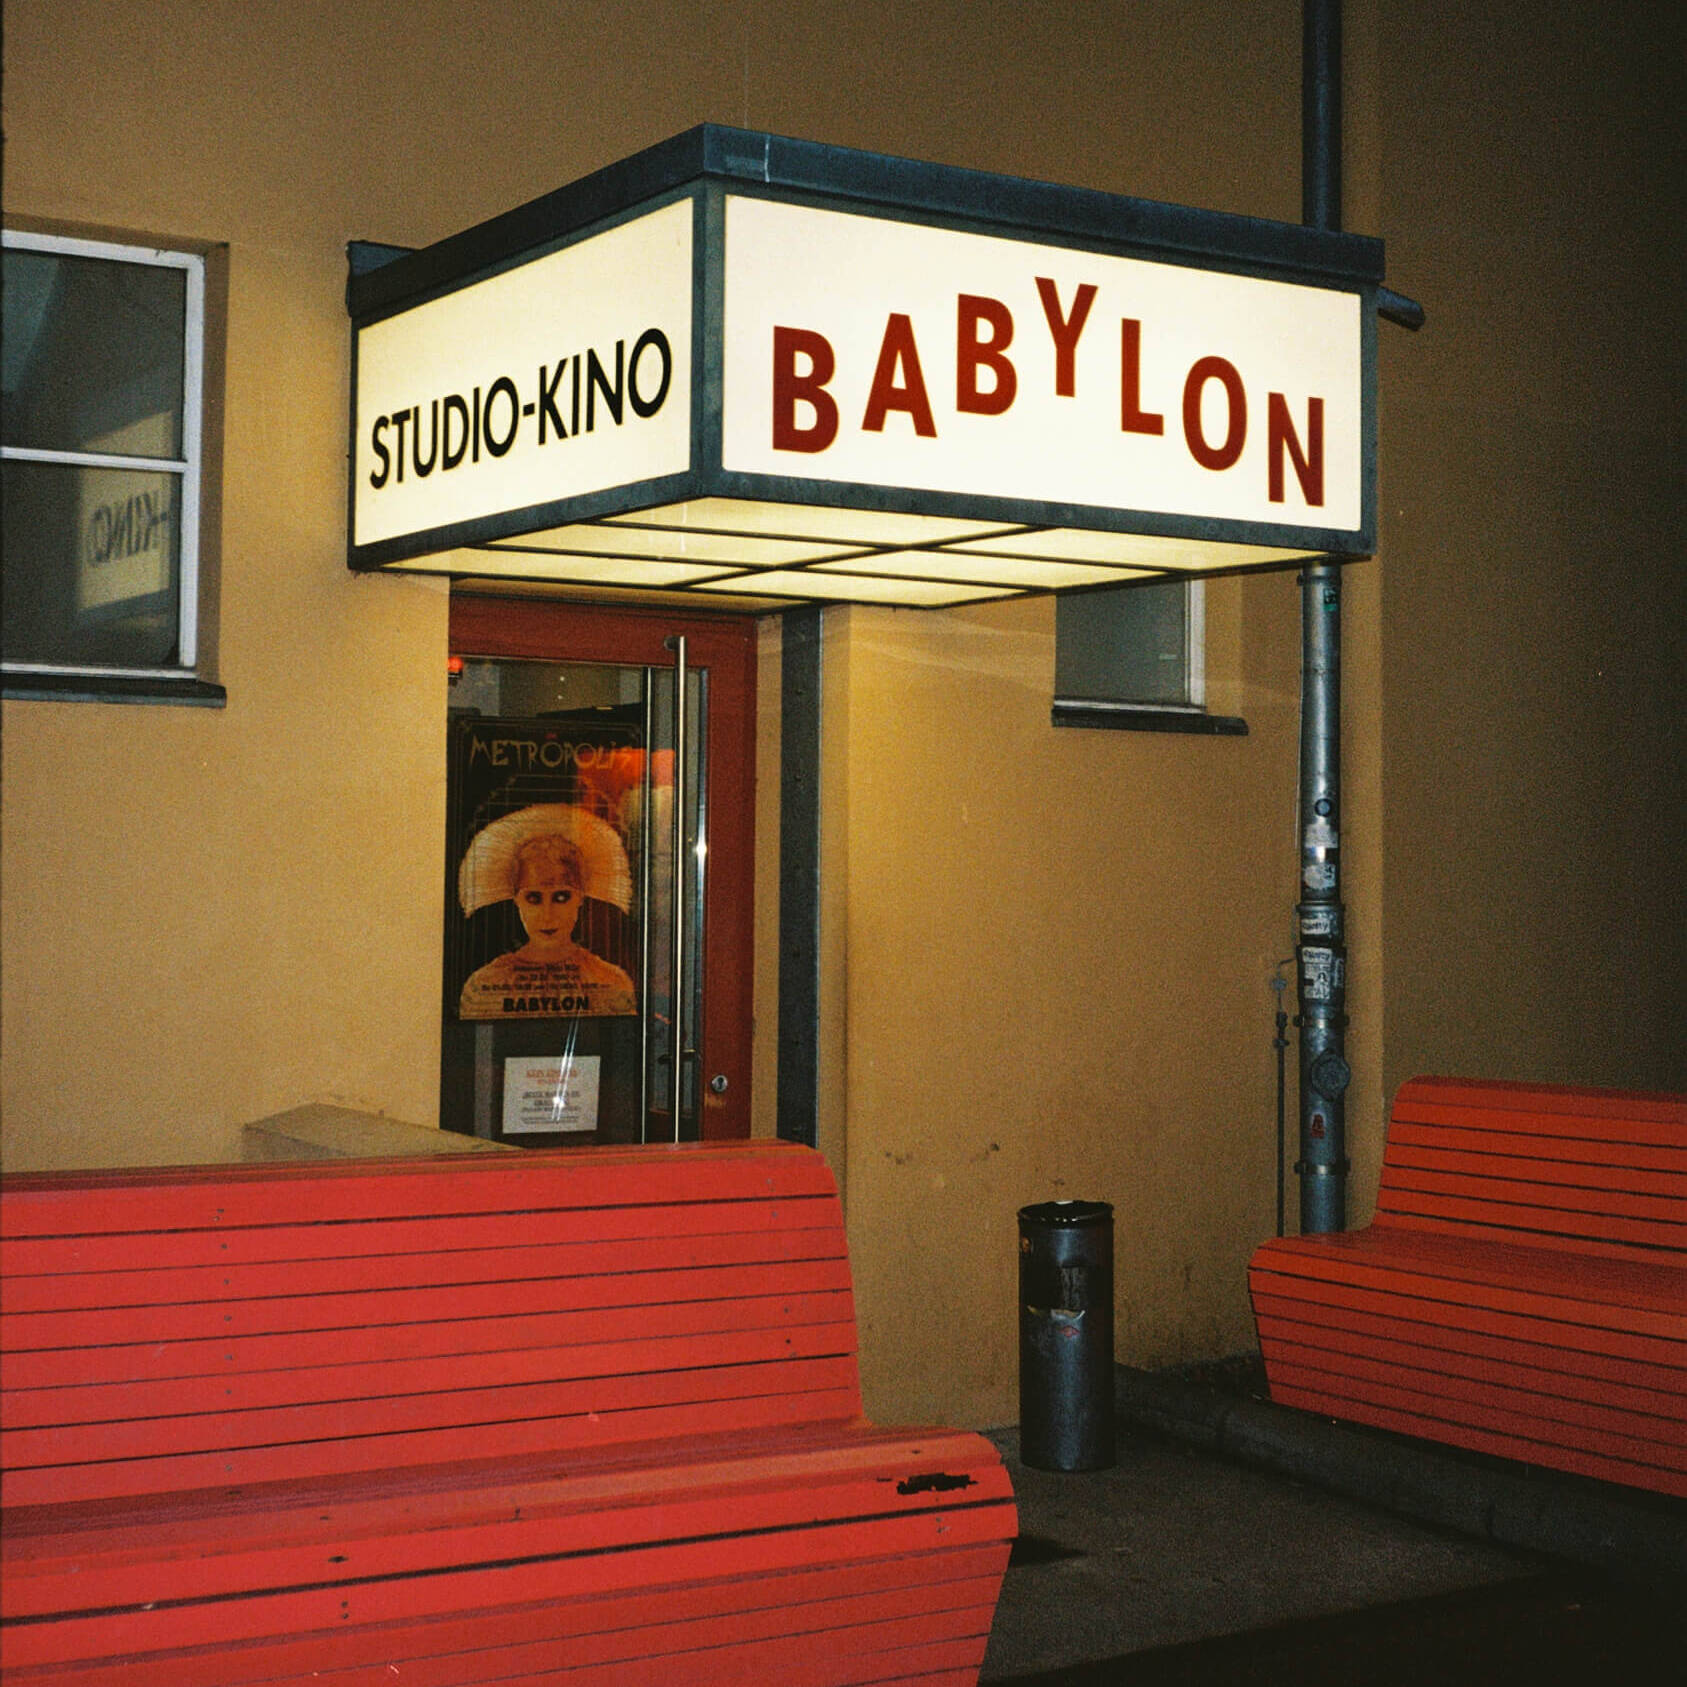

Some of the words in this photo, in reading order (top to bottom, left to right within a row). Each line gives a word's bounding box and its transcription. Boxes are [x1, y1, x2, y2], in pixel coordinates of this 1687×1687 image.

[369, 328, 673, 489] STUDIO-KINO
[772, 276, 1325, 507] BABYLON
[502, 996, 590, 1013] BABYLON
